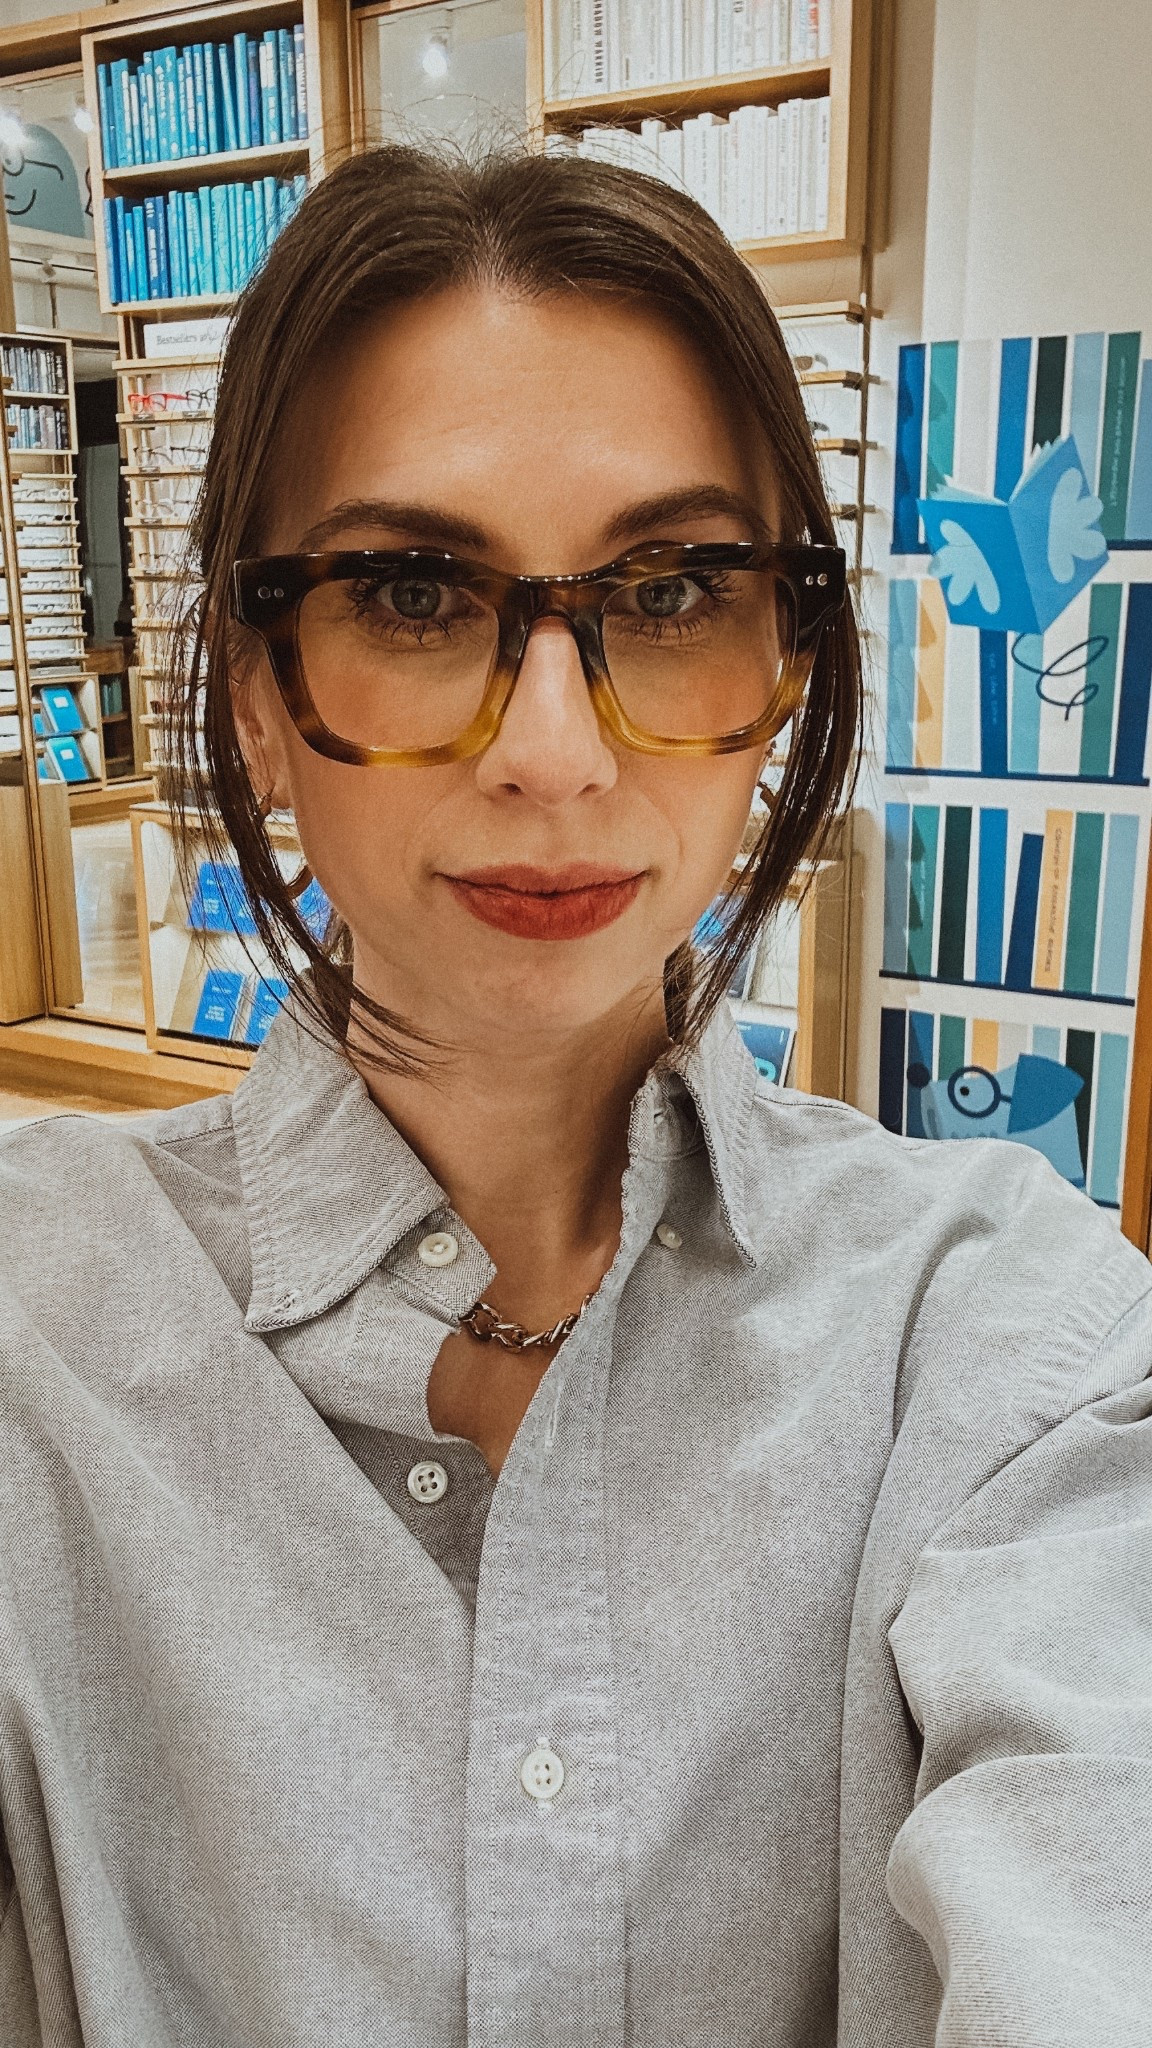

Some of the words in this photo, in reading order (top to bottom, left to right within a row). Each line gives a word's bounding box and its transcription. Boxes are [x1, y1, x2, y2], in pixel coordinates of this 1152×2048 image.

[593, 0, 603, 36] HADOW
[594, 40, 603, 84] WARRIOR
[156, 332, 198, 346] Bestsellers
